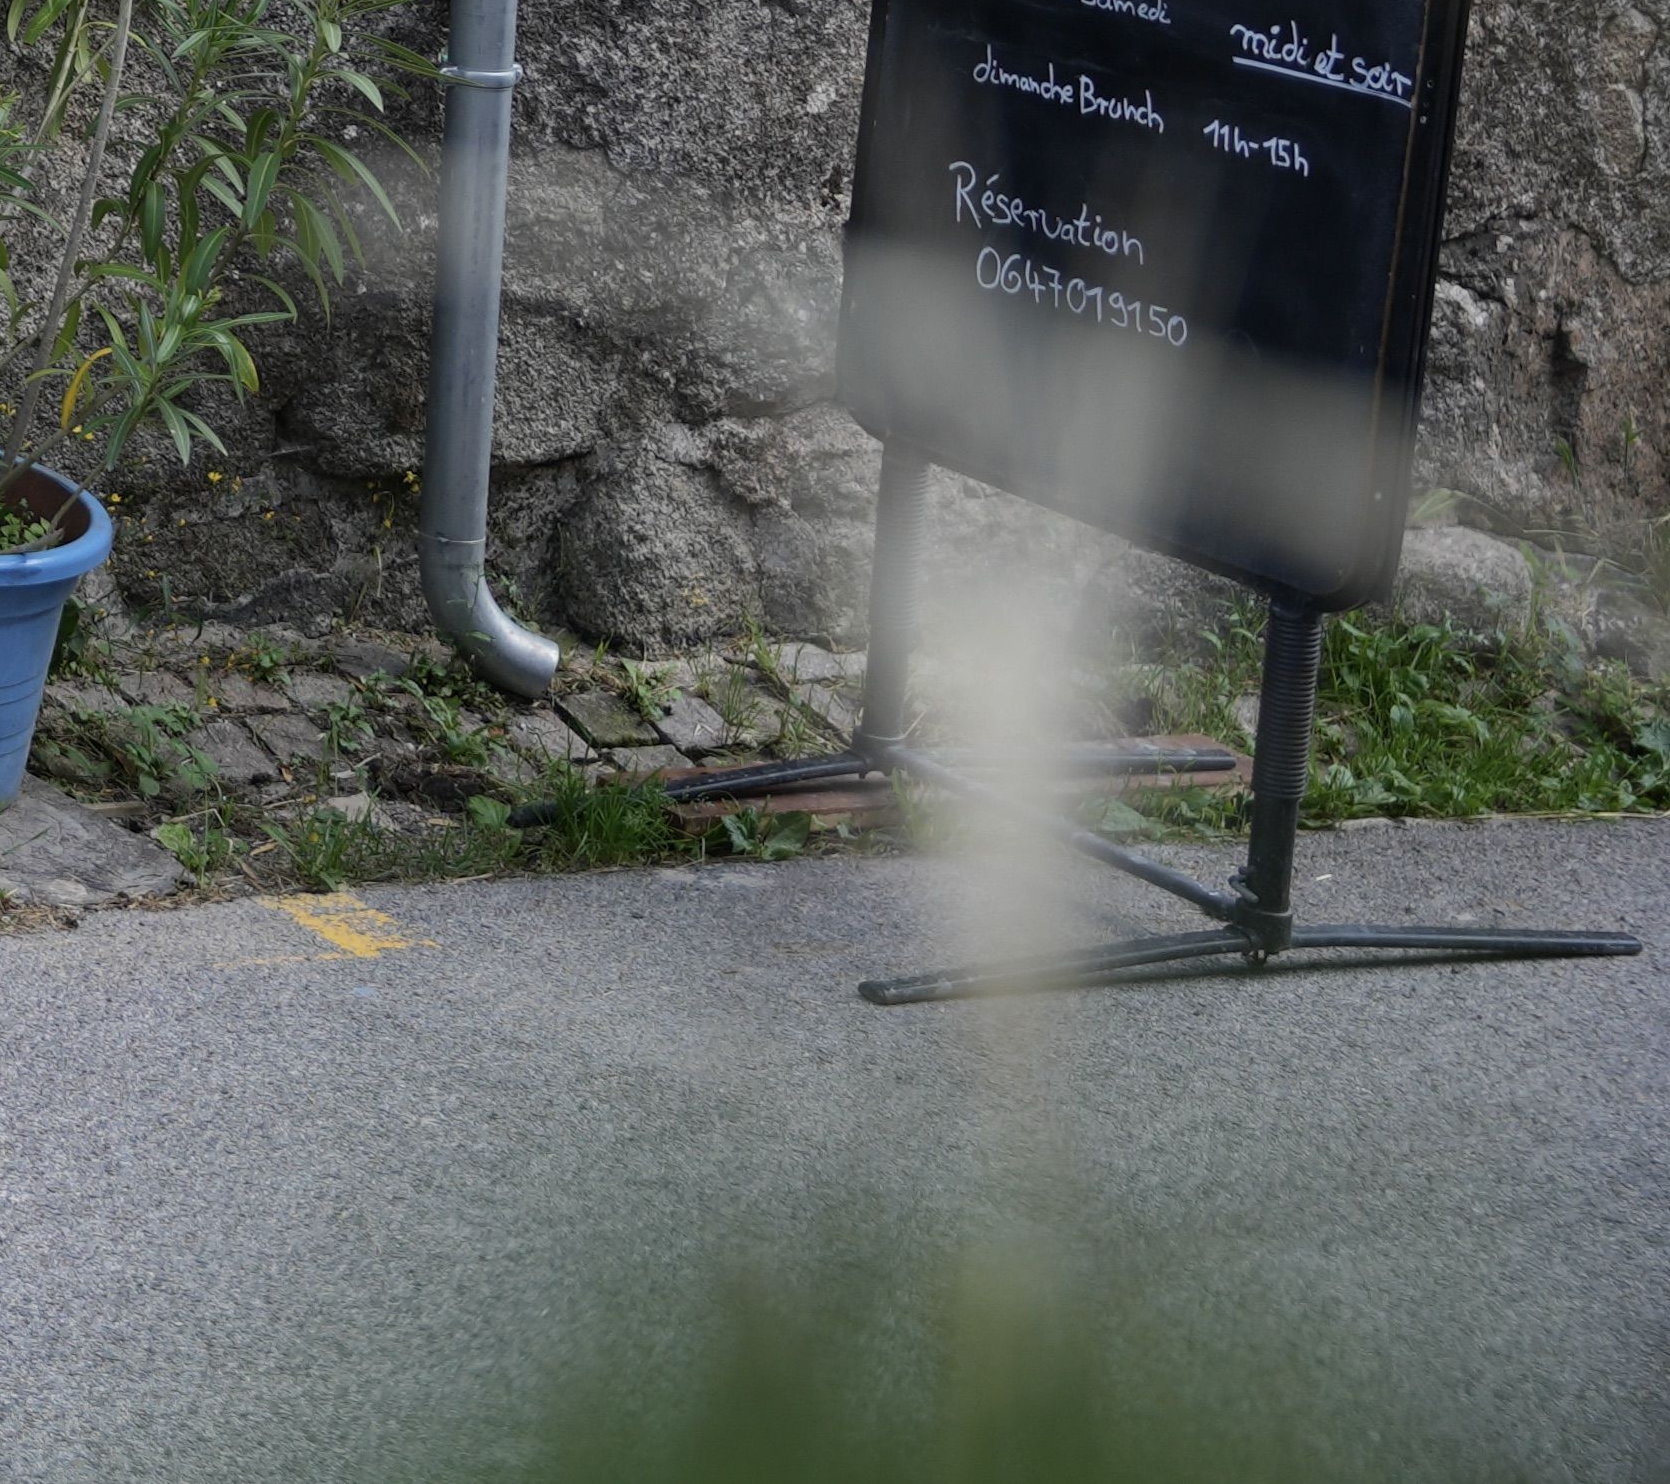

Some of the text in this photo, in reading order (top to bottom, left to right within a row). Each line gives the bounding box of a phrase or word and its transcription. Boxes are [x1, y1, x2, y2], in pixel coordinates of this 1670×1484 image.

[1230, 20, 1309, 65] midi
[1313, 33, 1345, 80] et
[973, 44, 1310, 177] dimanche Brunch 11h-15h
[948, 160, 1145, 265] Réservation
[976, 246, 1188, 347] 0647019150
